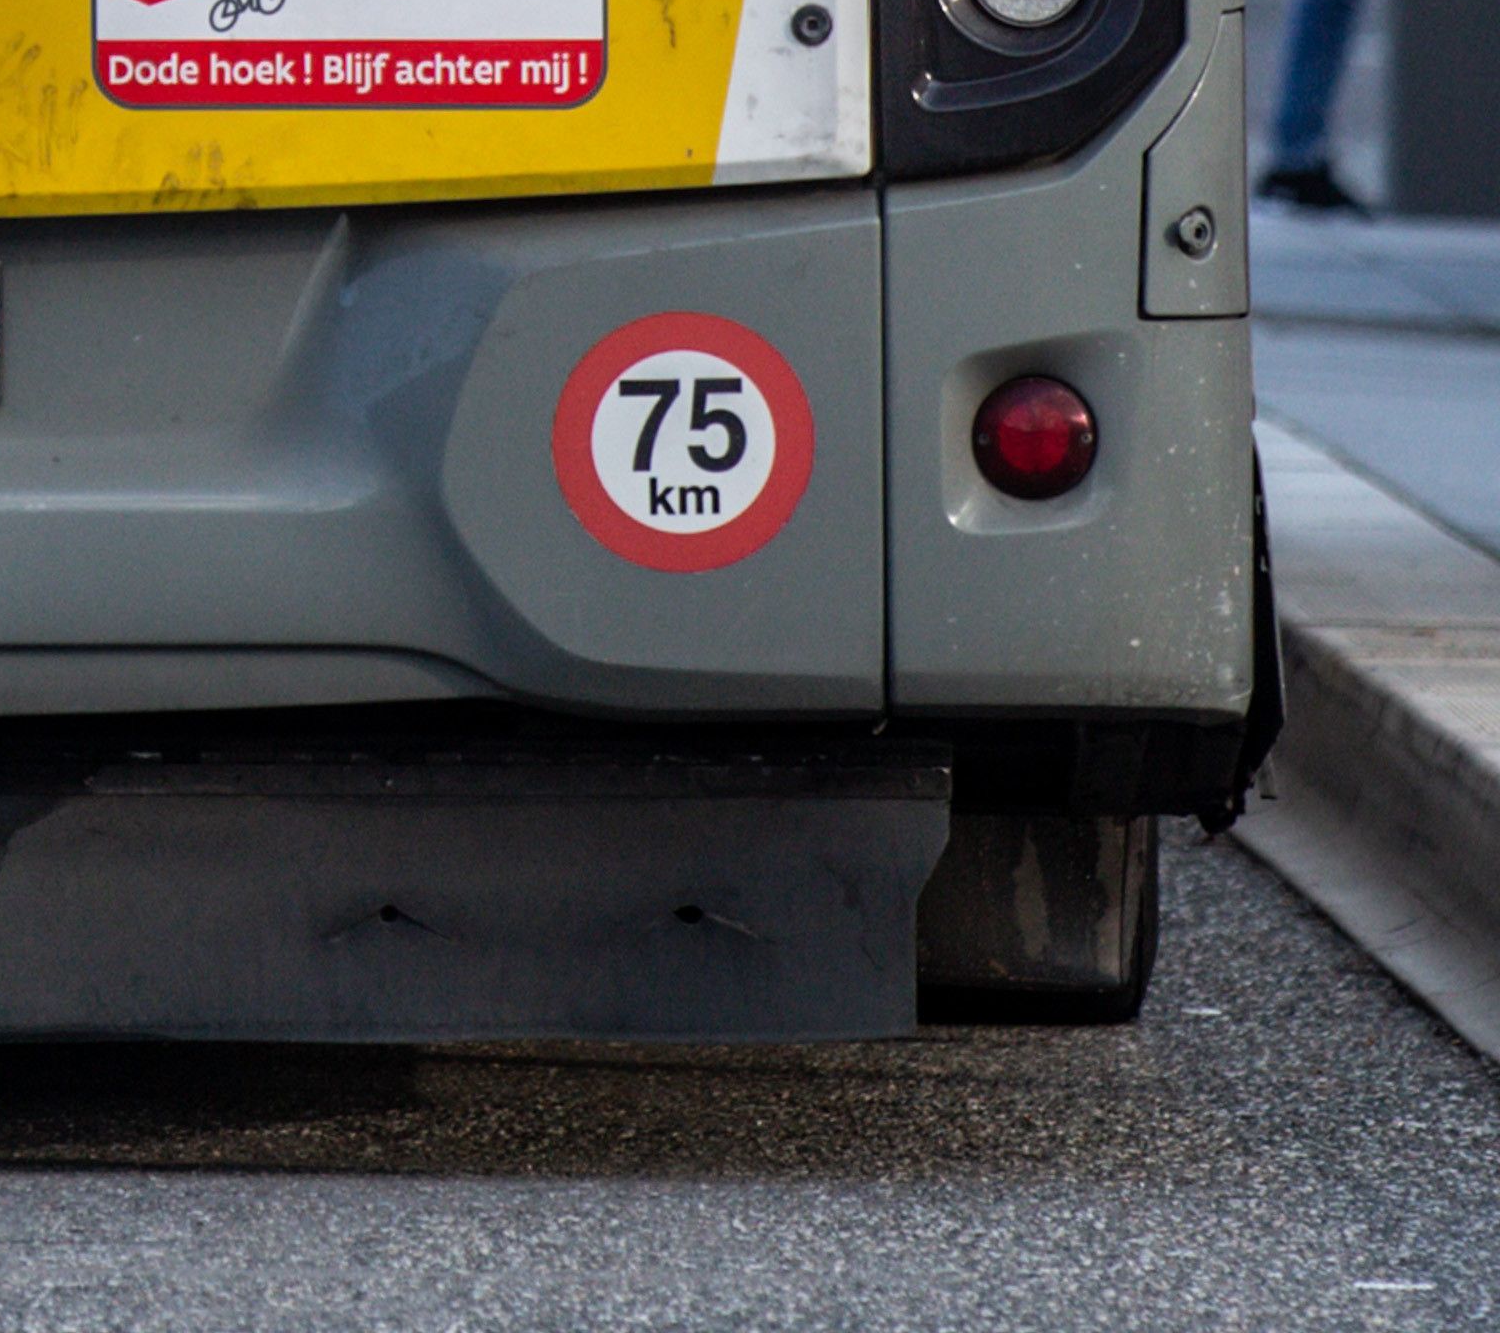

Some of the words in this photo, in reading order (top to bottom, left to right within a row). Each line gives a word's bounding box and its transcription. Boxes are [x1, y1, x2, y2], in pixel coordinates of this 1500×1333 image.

[107, 53, 199, 86] Dode
[323, 52, 387, 94] Blijf
[395, 53, 510, 86] achter
[618, 377, 748, 473] 75
[649, 477, 722, 516] km
